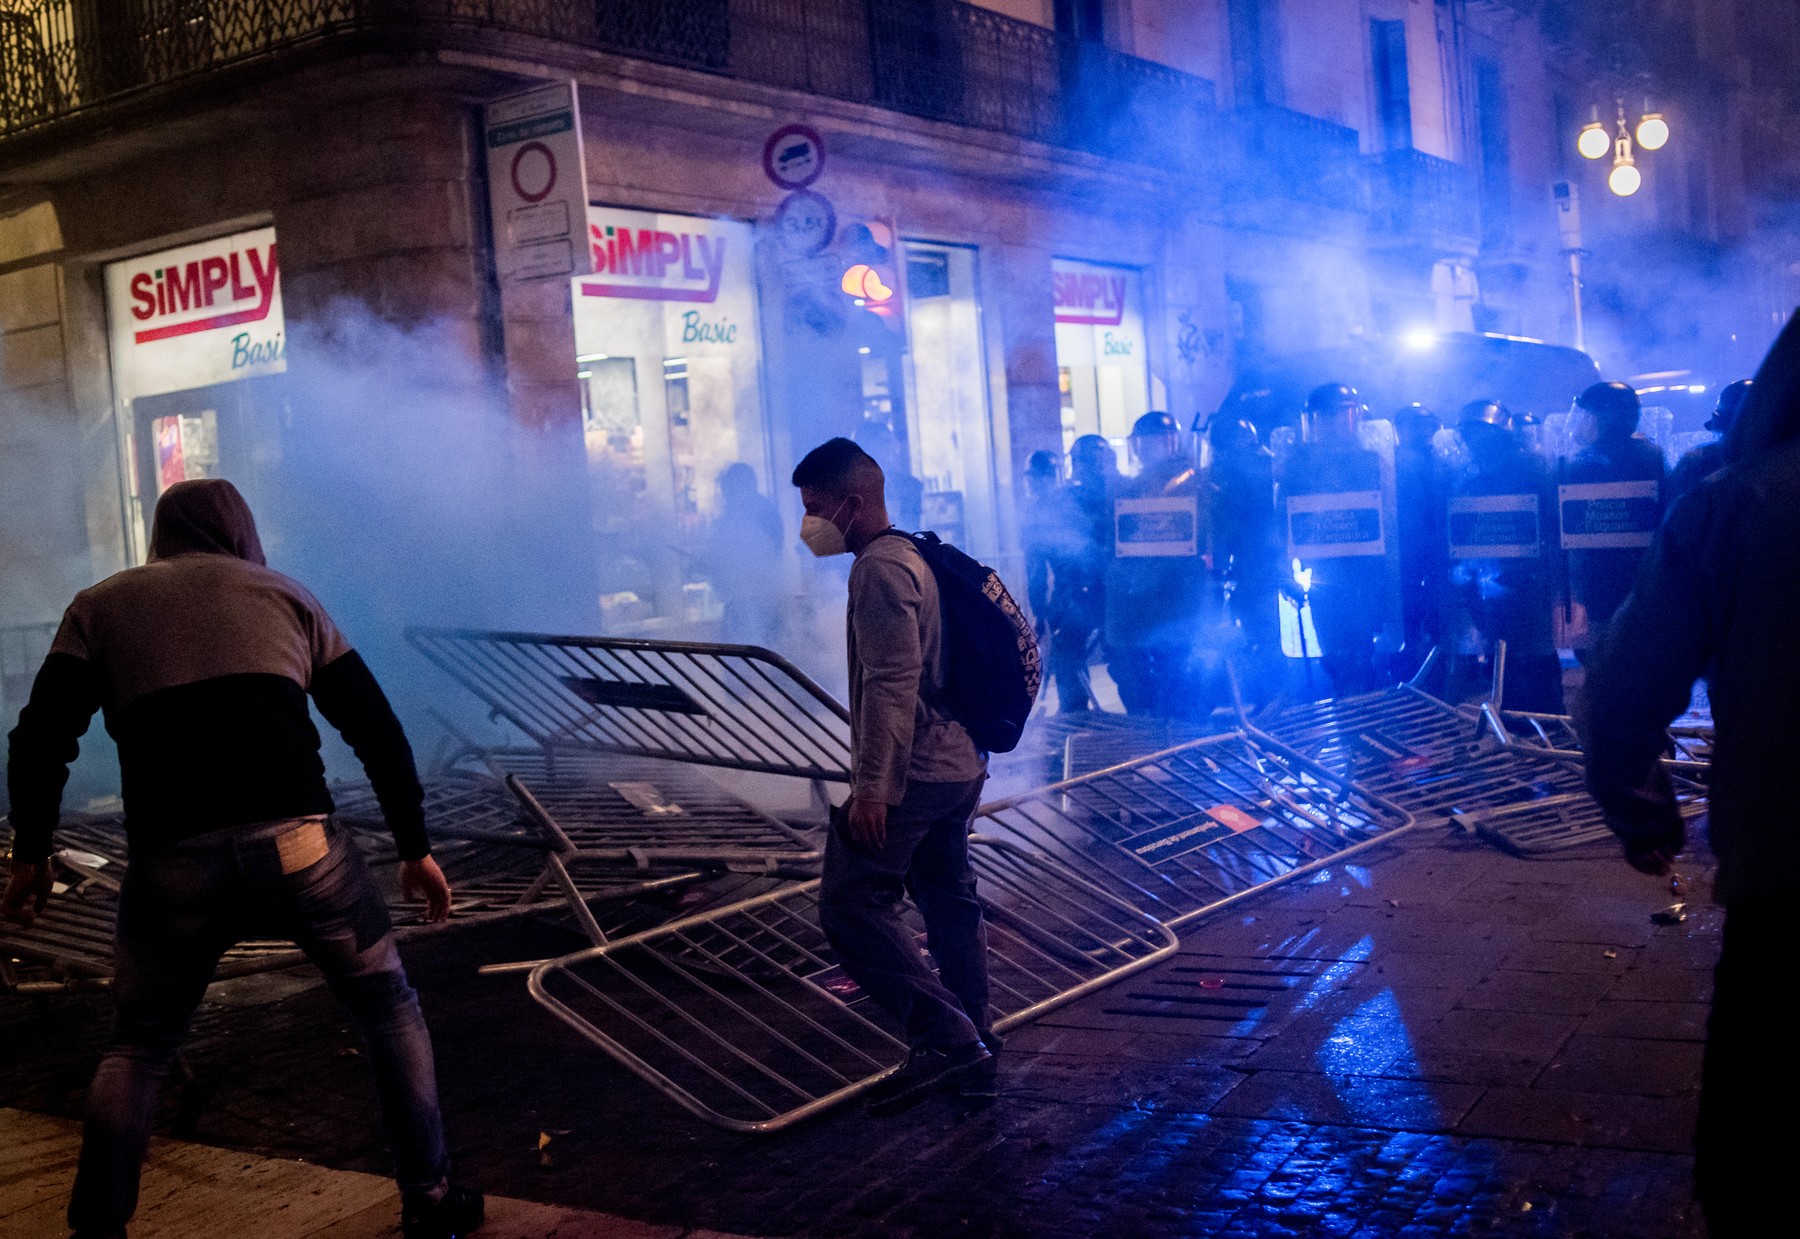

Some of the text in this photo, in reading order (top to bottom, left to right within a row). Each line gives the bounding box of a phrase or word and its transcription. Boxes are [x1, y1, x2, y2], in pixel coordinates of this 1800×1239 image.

[682, 310, 737, 344] Basic
[231, 331, 288, 369] Basi
[1103, 332, 1134, 357] Basic
